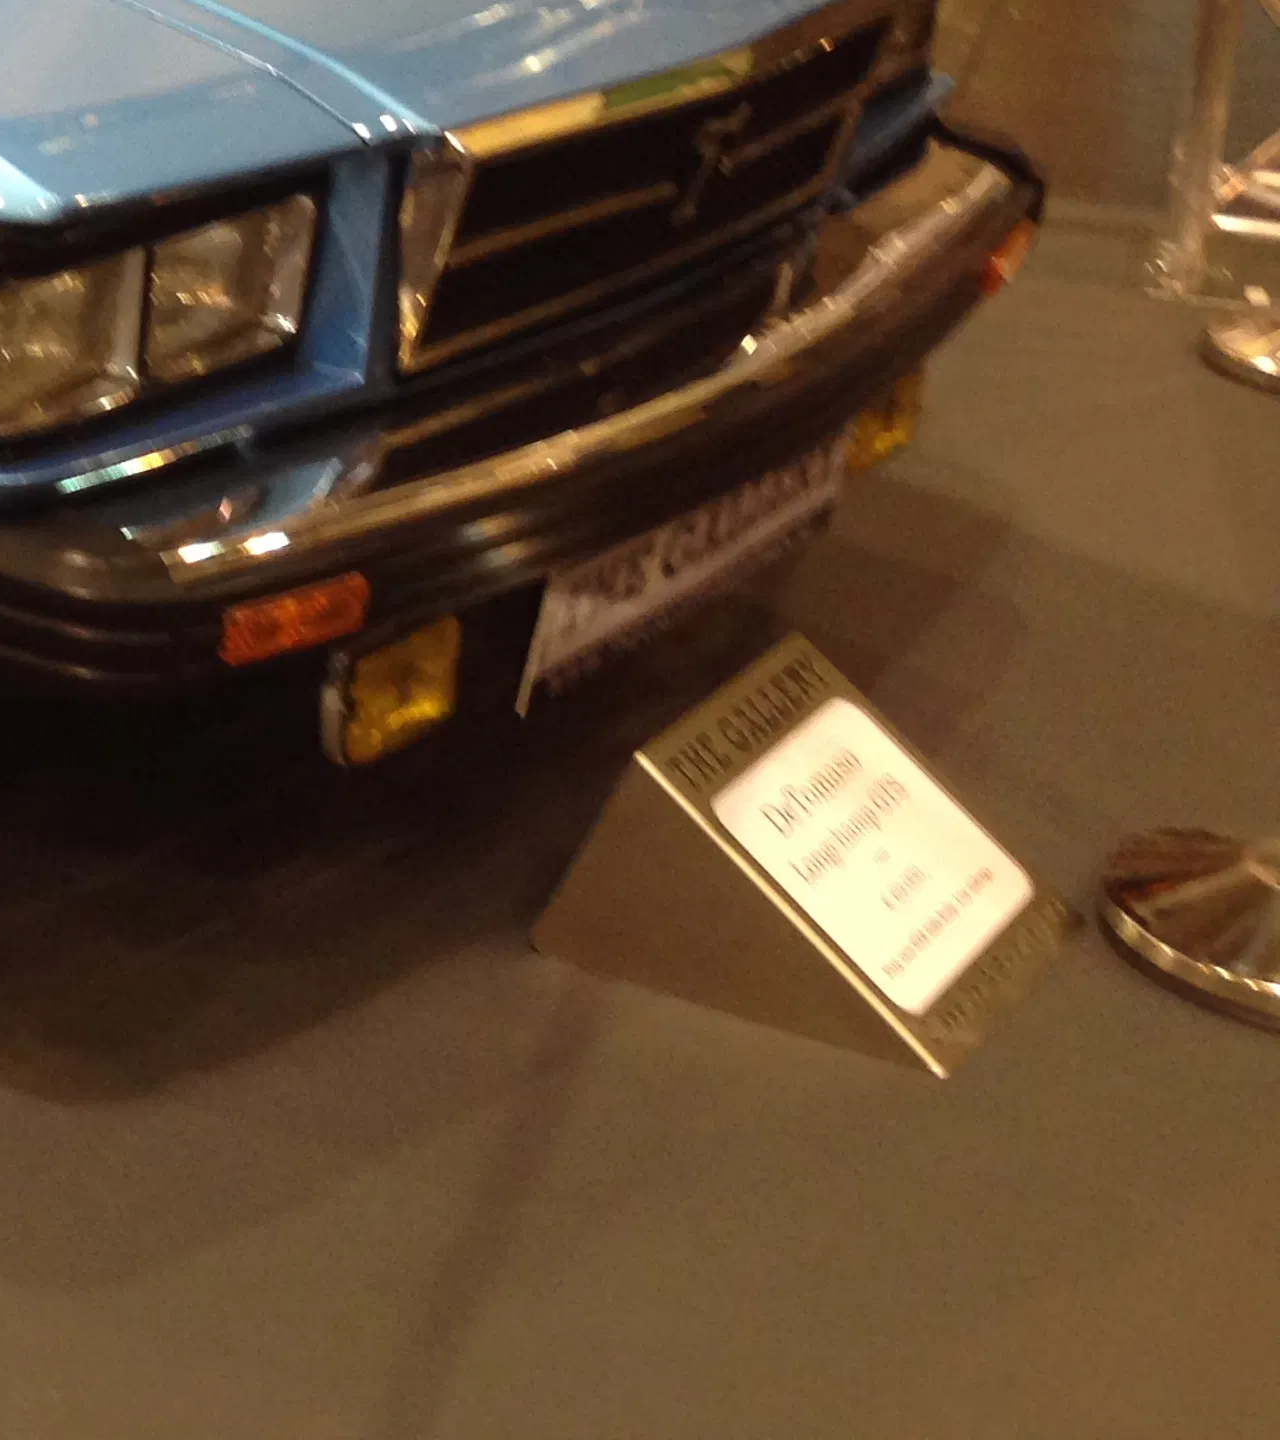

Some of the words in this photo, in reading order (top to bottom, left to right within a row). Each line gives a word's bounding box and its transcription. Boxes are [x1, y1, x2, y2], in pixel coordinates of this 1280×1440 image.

[665, 731, 733, 794] THE
[716, 651, 830, 753] GALLERY
[760, 747, 863, 840] DeTomaso
